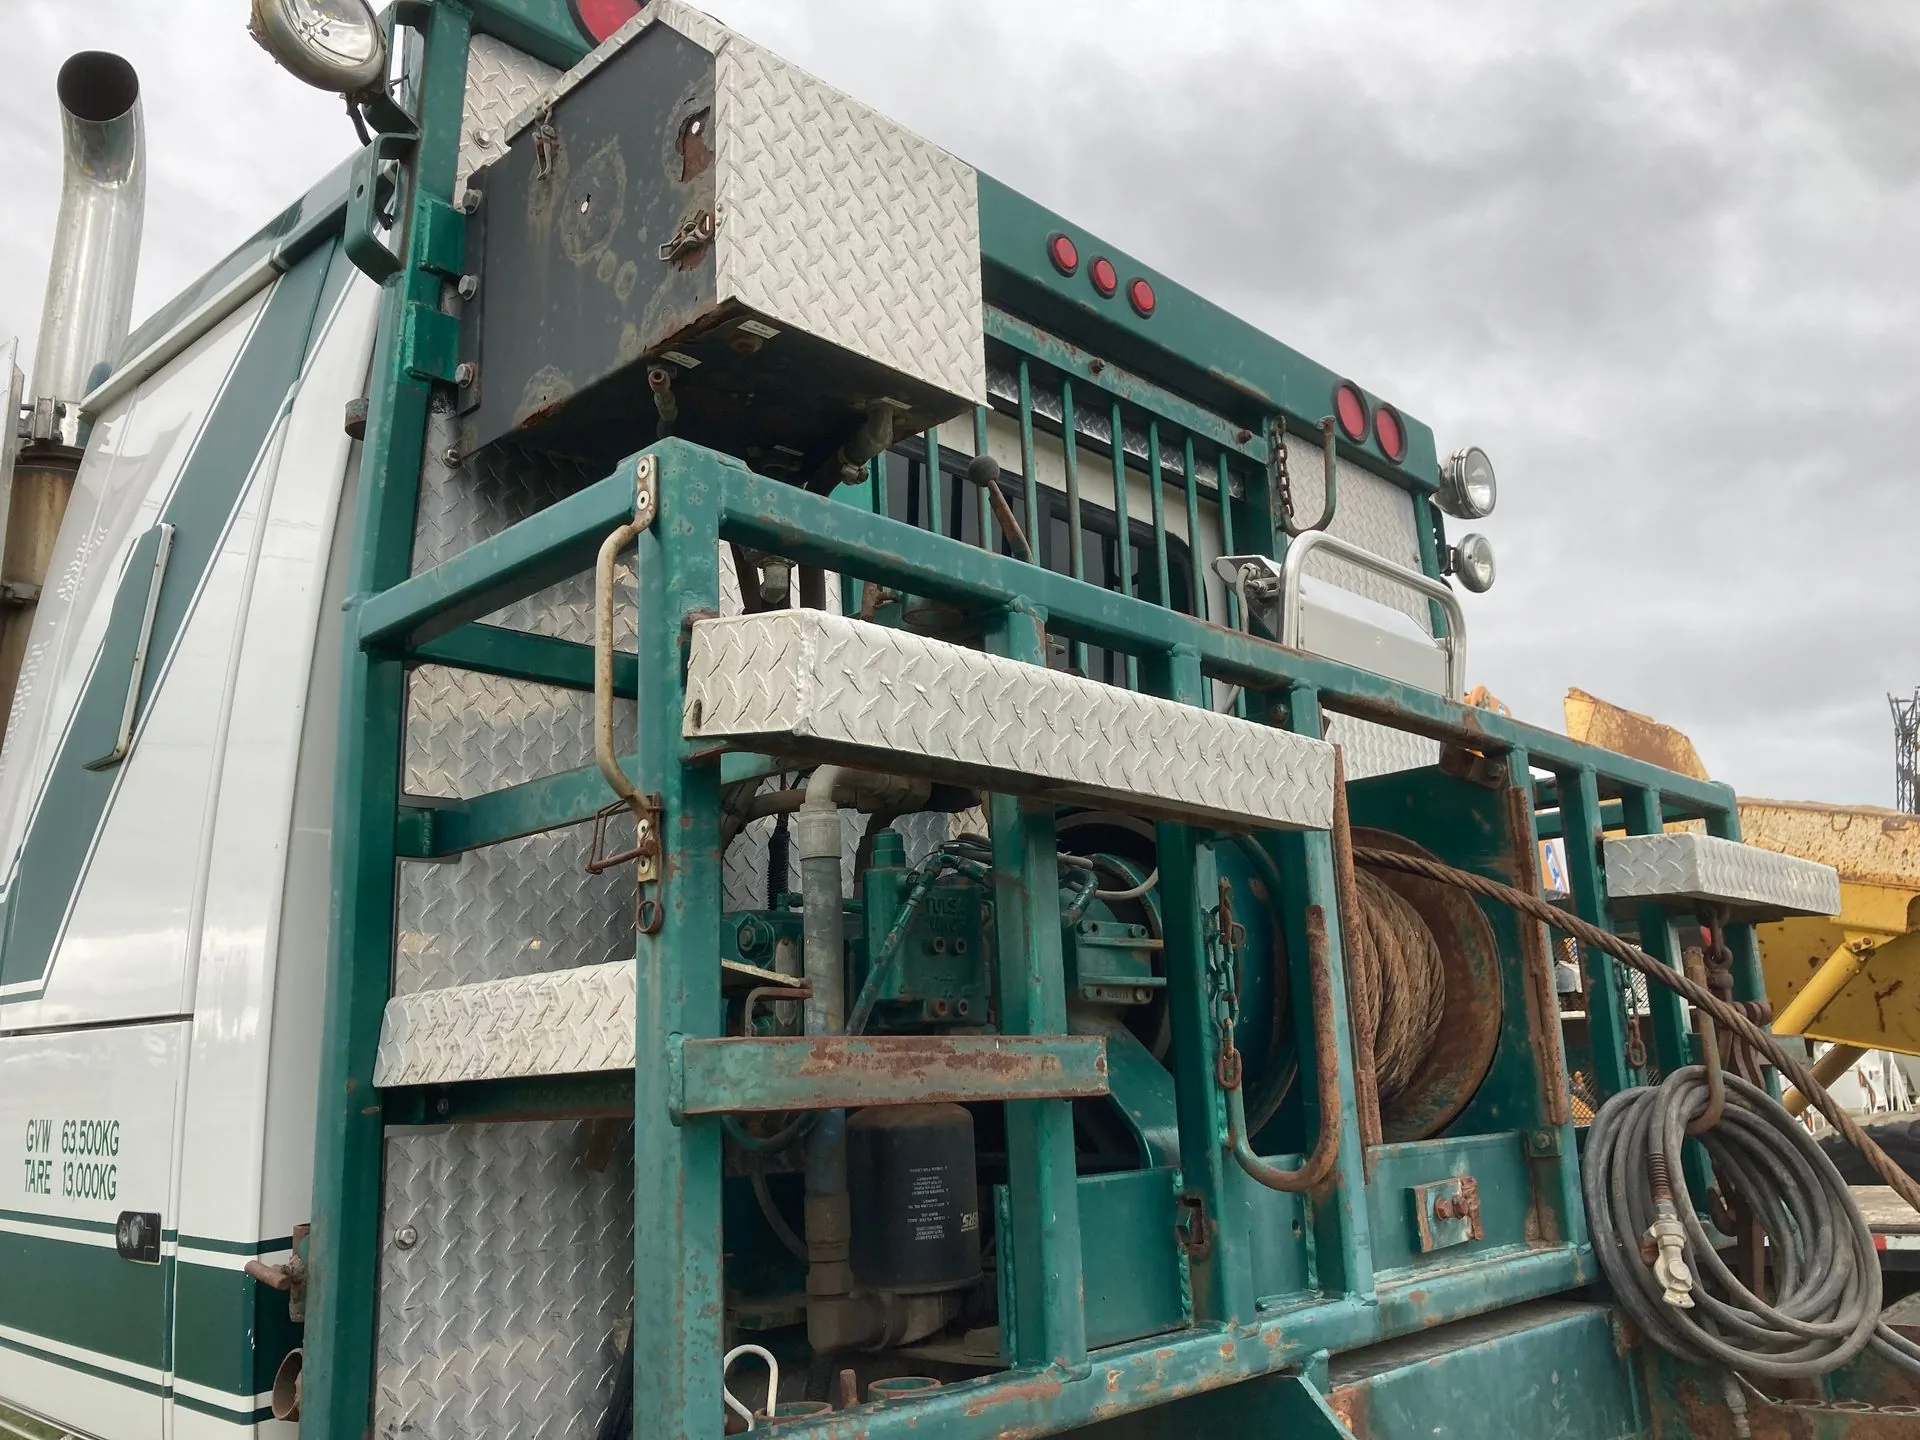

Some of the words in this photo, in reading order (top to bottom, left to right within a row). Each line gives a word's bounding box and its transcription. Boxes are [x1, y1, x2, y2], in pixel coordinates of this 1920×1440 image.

[26, 1119, 52, 1153] GVW
[61, 1120, 120, 1159] 63,500KG
[24, 1159, 53, 1195] TARE
[62, 1161, 118, 1202] 13,000KG
